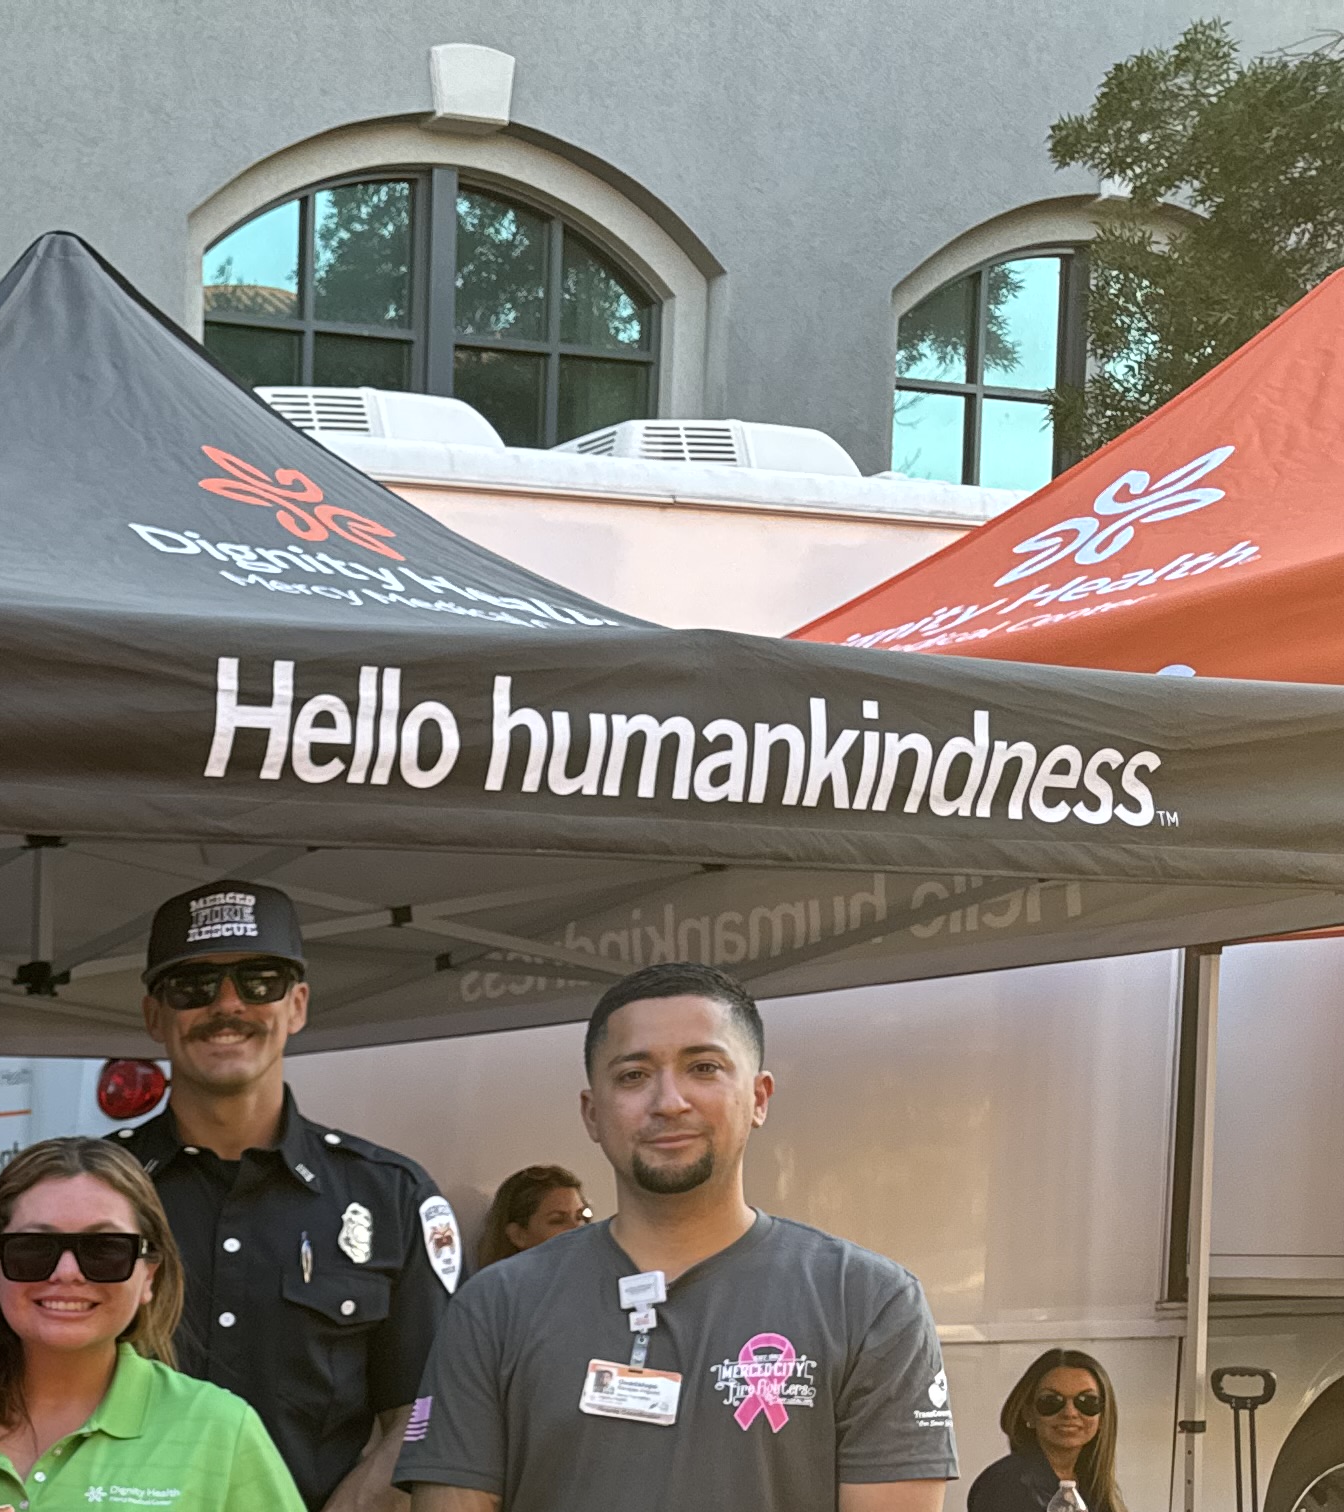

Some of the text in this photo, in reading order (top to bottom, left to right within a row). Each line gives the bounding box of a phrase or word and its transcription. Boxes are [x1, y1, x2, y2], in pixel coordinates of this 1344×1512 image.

[128, 522, 405, 592] Dignity
[218, 570, 363, 607] Mercy
[998, 540, 1261, 615] Health
[203, 656, 461, 789] Hello
[485, 675, 1162, 828] humankindness
[189, 891, 256, 913] MERCED
[190, 904, 255, 929] FIRE
[186, 923, 259, 942] RESCUE
[721, 1361, 805, 1380] MERCED CITY
